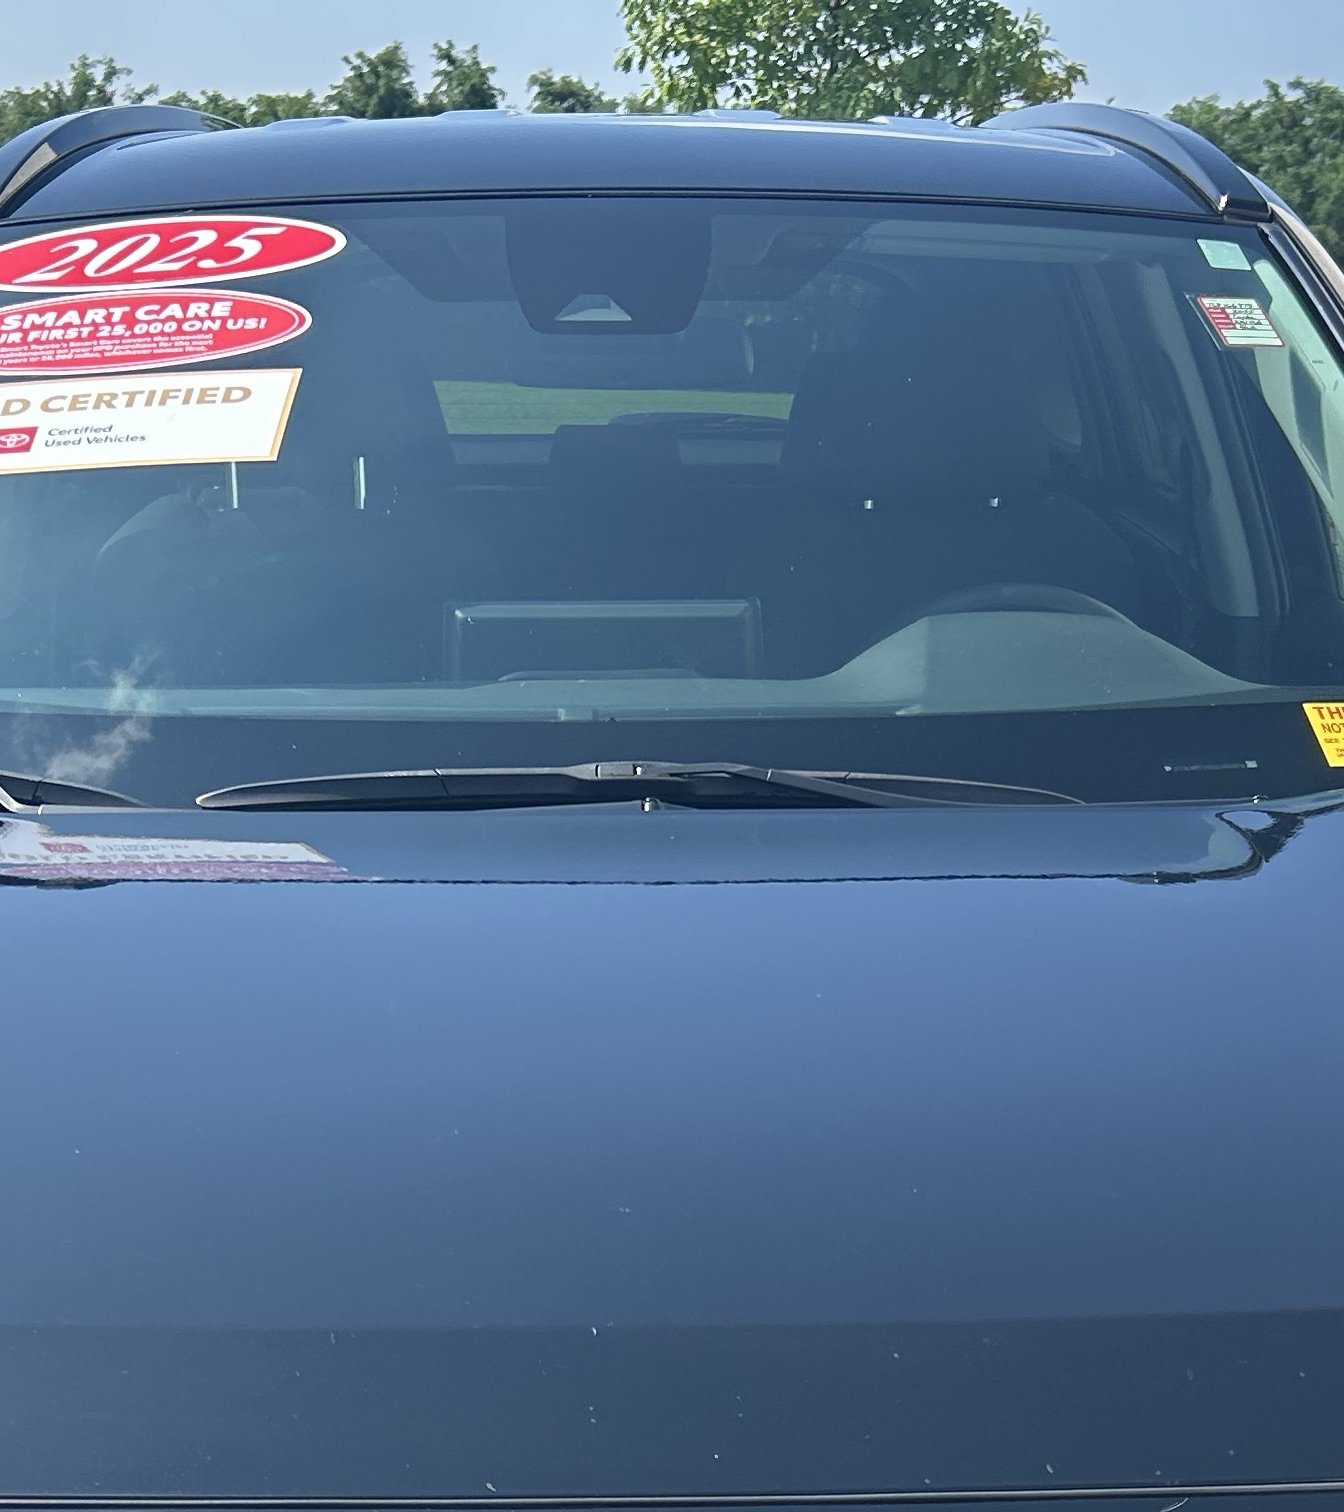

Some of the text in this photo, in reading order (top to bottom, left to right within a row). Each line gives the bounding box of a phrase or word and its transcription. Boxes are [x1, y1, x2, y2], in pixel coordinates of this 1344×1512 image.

[11, 227, 288, 284] 2025
[0, 301, 233, 331] SMART CARE
[26, 325, 95, 343] FIRST
[96, 320, 178, 338] 25,000
[181, 318, 222, 332] ON
[224, 316, 268, 330] US!
[40, 386, 253, 413] CERTIFIED
[44, 434, 146, 447] Used Vehicles
[48, 424, 113, 436] Certified
